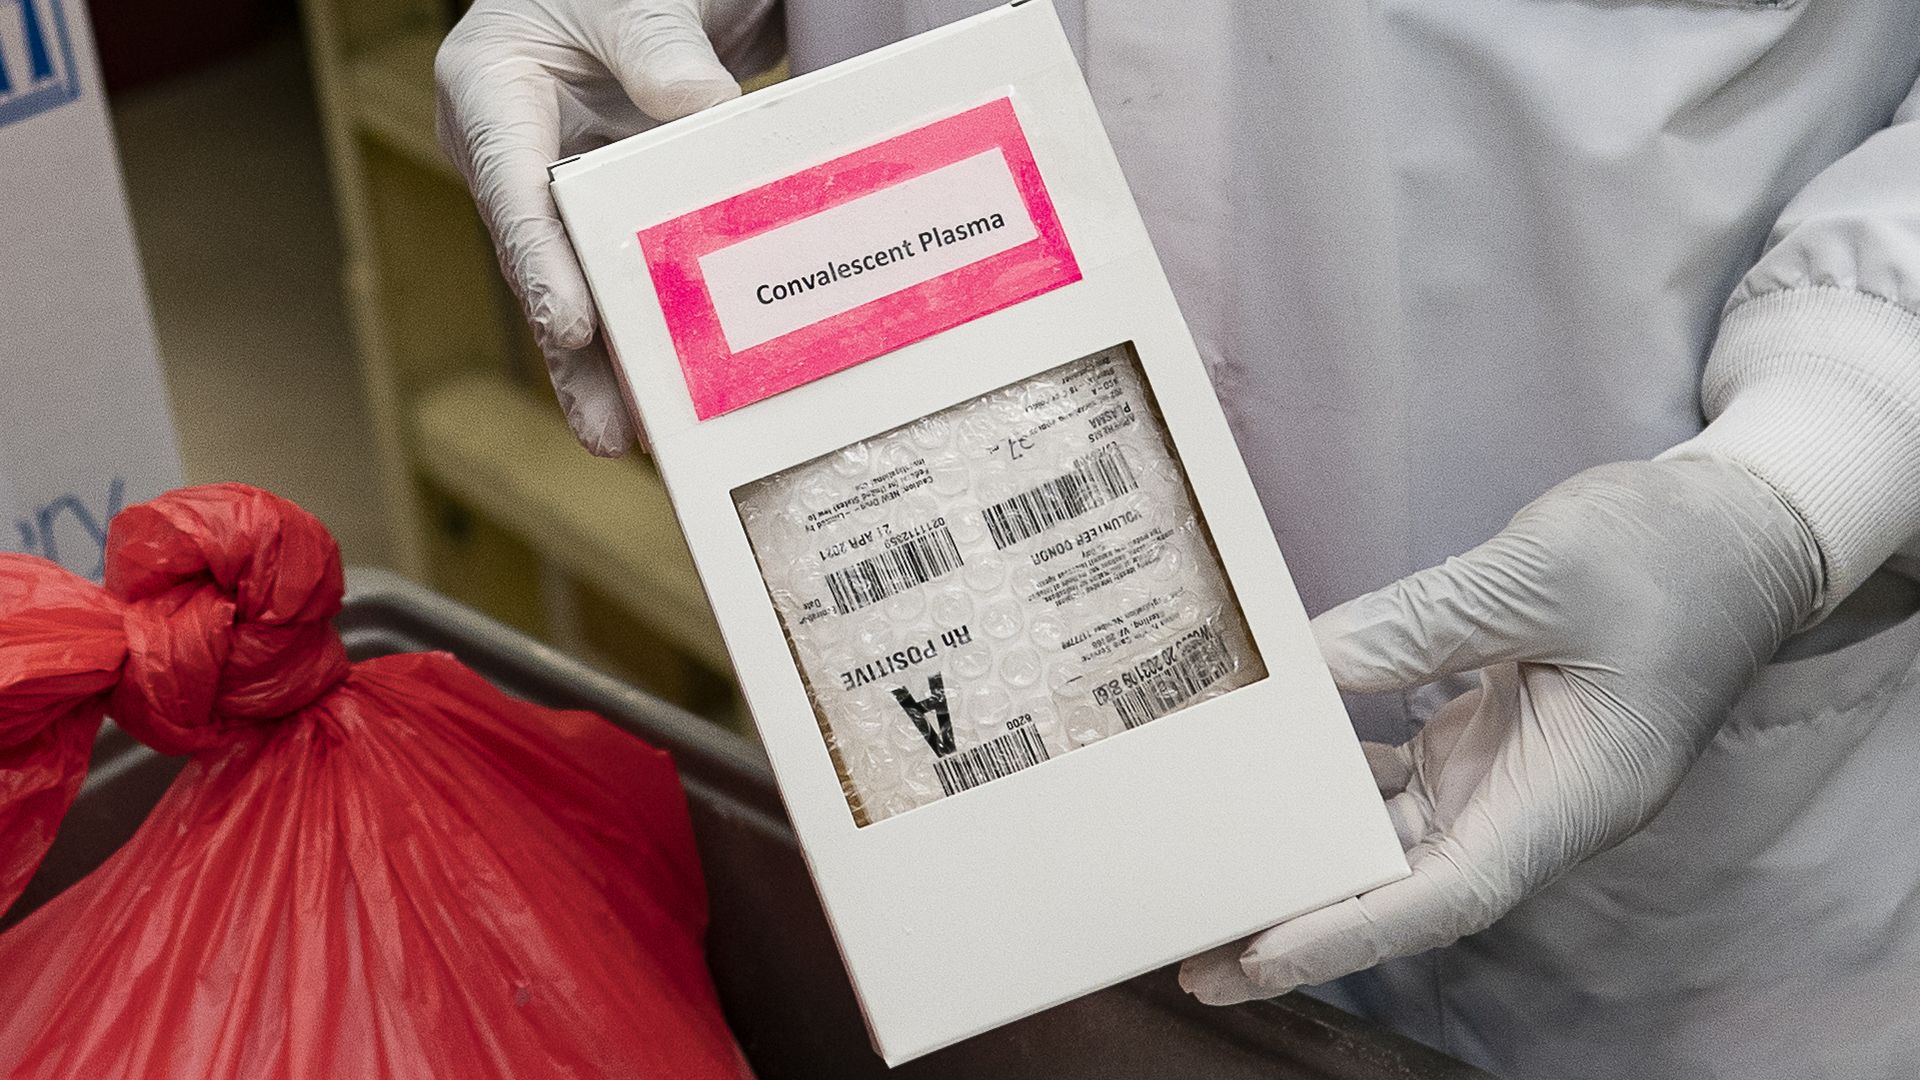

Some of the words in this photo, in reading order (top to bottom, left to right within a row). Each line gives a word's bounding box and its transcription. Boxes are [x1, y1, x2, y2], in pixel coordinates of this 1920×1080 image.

[756, 240, 916, 306] Convalescent
[918, 211, 1006, 255] Plasma
[1087, 401, 1131, 429] PLASMA
[847, 530, 875, 550] APR
[876, 522, 892, 538] 21
[883, 515, 945, 549] 0211112359
[1073, 506, 1142, 546] VOLUNTEER
[818, 541, 848, 561] 2021
[1029, 538, 1073, 566] DONOR
[941, 624, 972, 651] Rh
[839, 639, 937, 691] POSITIVE
[890, 671, 956, 758] A
